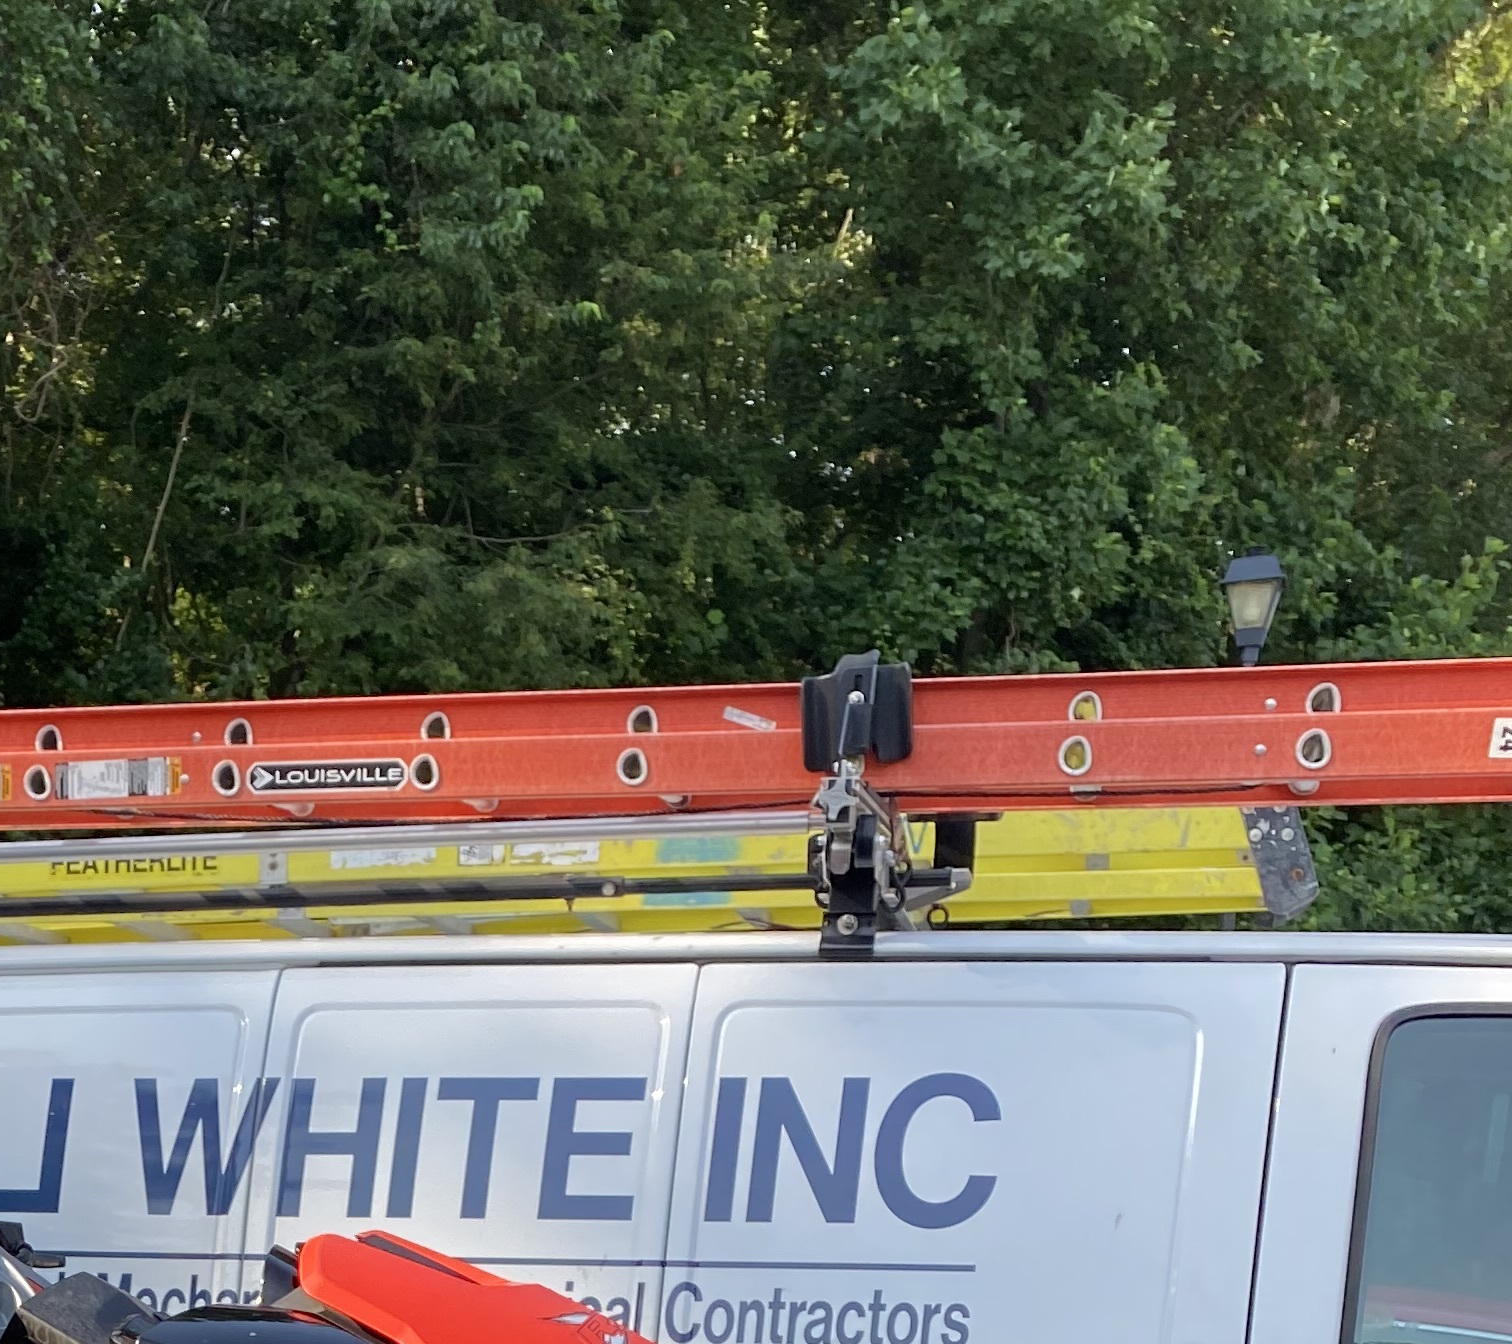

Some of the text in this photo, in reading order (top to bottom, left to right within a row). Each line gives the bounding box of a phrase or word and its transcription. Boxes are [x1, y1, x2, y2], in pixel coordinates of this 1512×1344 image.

[274, 766, 403, 785] LOUISVILLE
[133, 1077, 648, 1220] WHITE
[704, 1073, 1003, 1230] INC
